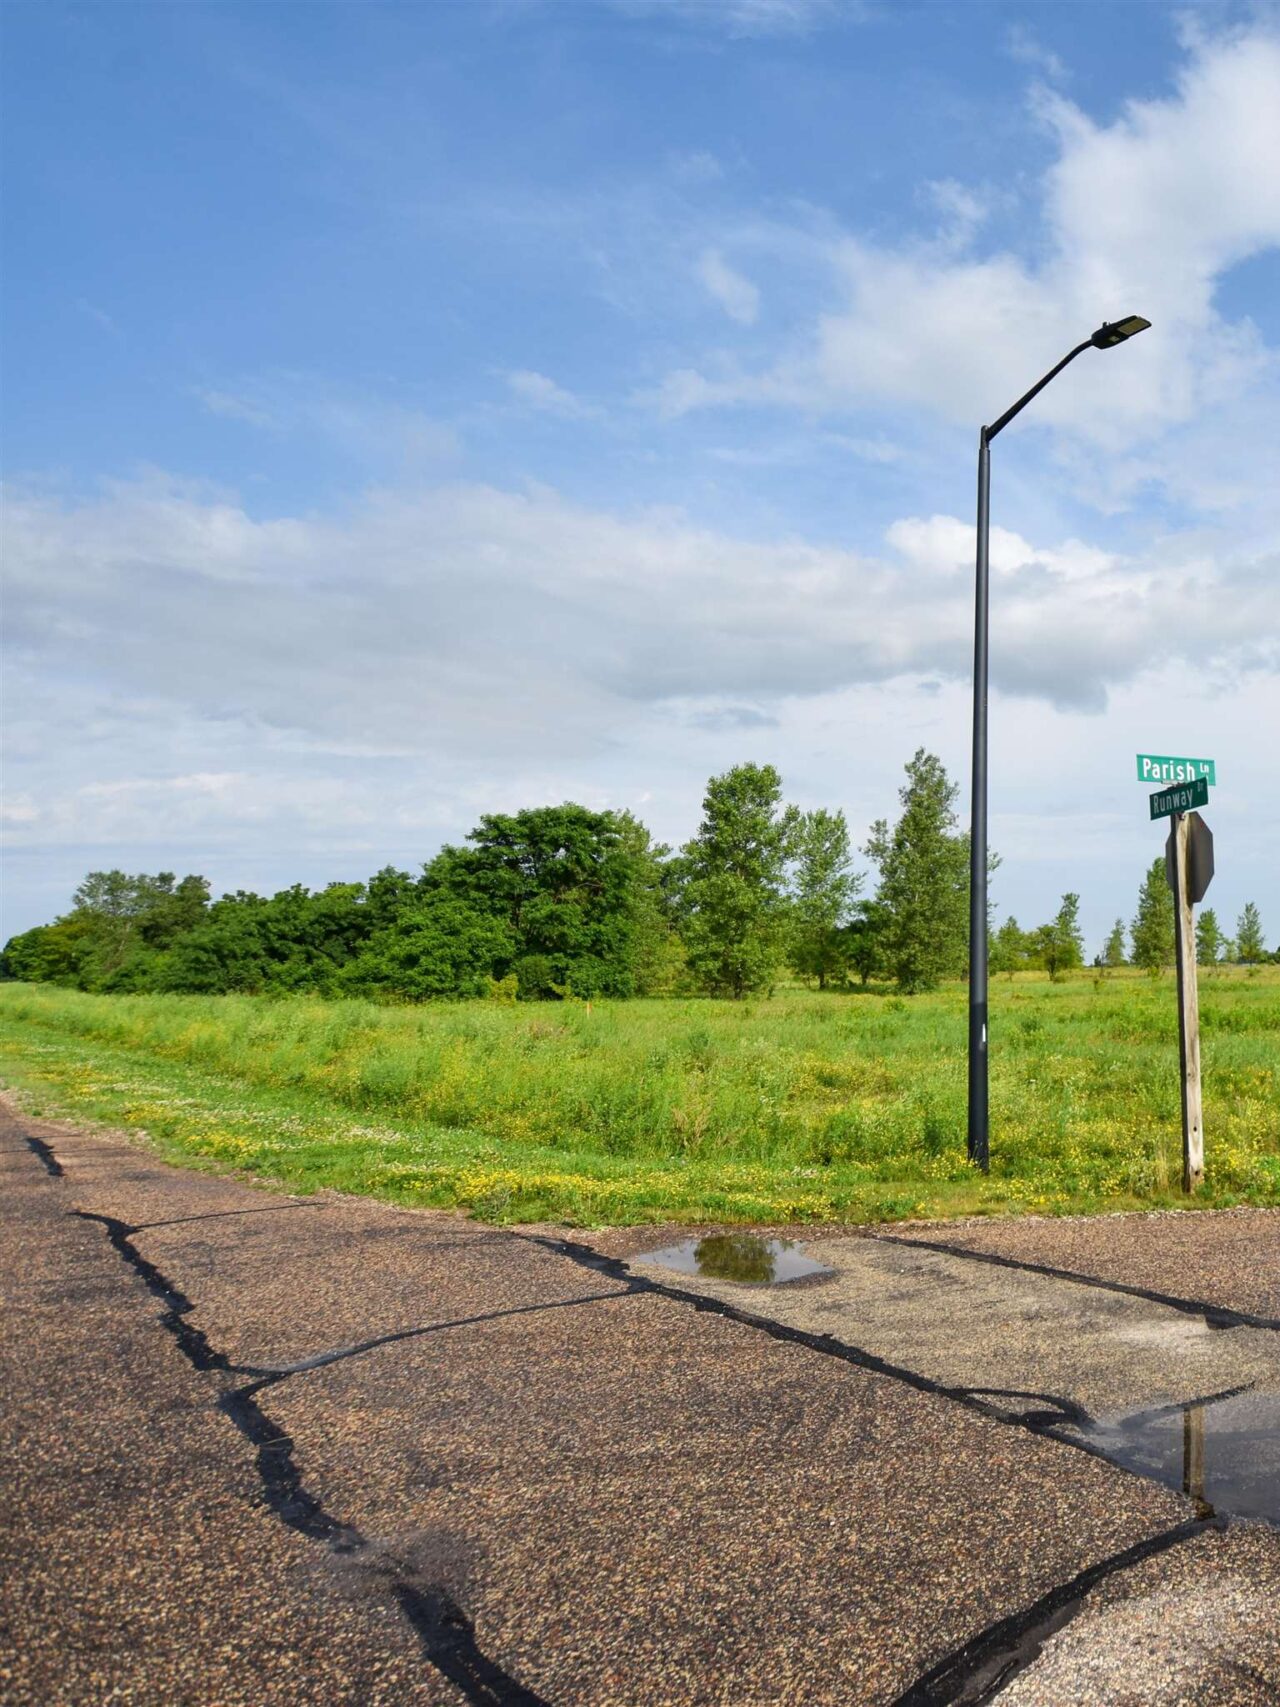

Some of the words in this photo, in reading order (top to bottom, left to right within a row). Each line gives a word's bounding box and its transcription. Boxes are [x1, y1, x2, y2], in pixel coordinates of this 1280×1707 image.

[1143, 758, 1195, 781] Parish
[1200, 762, 1209, 773] Ln
[1153, 788, 1193, 814] Runway
